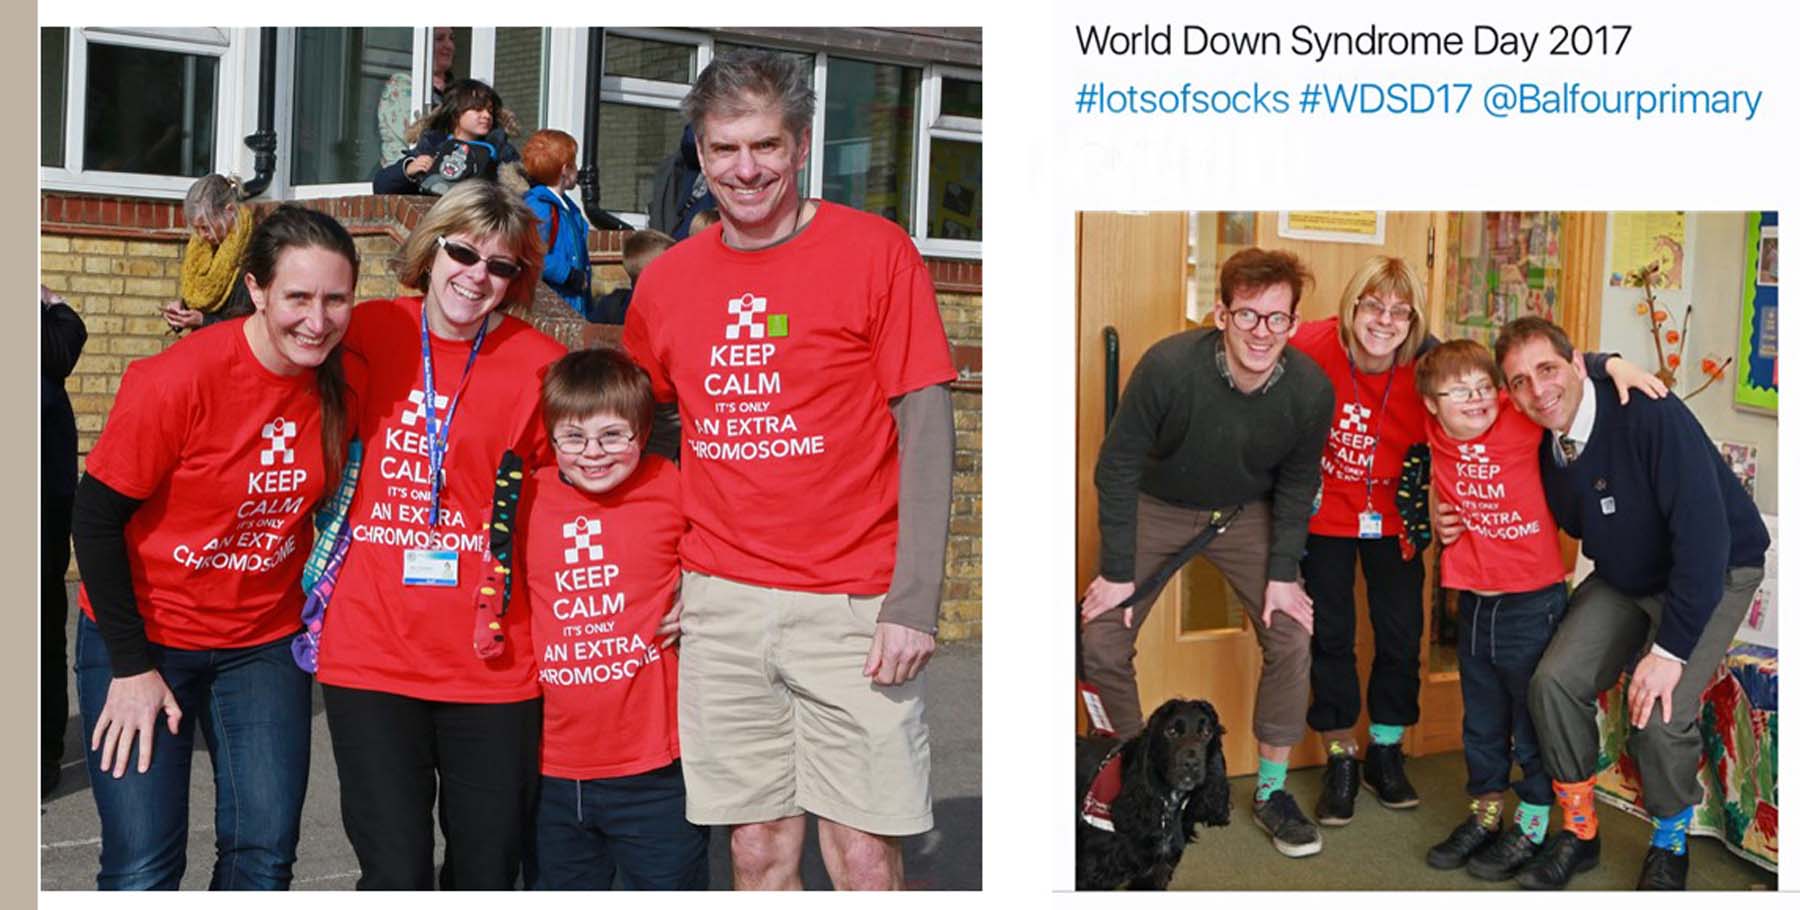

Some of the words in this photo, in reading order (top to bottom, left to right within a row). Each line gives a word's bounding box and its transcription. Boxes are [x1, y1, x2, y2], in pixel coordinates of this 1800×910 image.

[710, 343, 776, 367] KEEP
[704, 372, 781, 396] CALM
[715, 402, 736, 413] IT'S
[739, 401, 771, 413] ONLY
[727, 414, 798, 437] EXTRA
[386, 427, 449, 457] KEE
[688, 435, 825, 460] HROMOSOME
[1330, 427, 1375, 450] KEEP
[247, 469, 307, 494] KEEP
[1456, 462, 1500, 480] KEEP
[388, 486, 408, 498] IT'S
[1456, 481, 1505, 499] CALM
[237, 496, 304, 519] CALM
[370, 501, 392, 521] AN
[399, 503, 466, 528] EXRA
[255, 519, 285, 530] ONLY
[237, 532, 283, 551] EXT
[353, 524, 484, 552] CHROMOSOME
[554, 564, 620, 593] KEEP
[552, 592, 625, 621] CALM
[563, 623, 581, 637] IT'S
[584, 621, 615, 635] ONLY
[543, 643, 568, 662] AN
[574, 633, 647, 661] EXTRA
